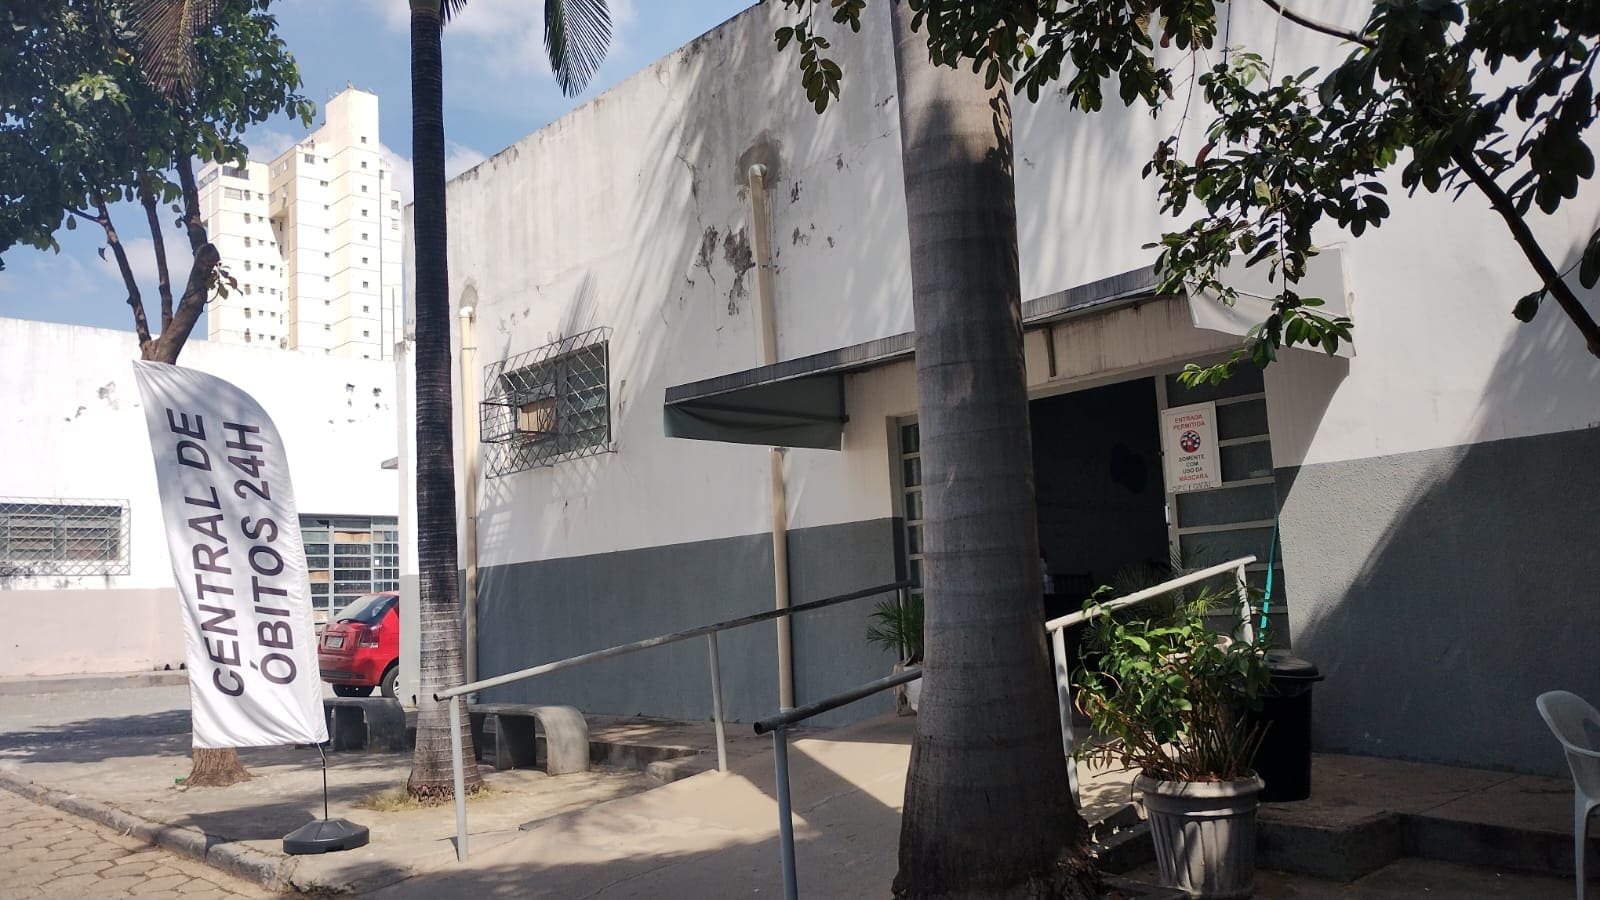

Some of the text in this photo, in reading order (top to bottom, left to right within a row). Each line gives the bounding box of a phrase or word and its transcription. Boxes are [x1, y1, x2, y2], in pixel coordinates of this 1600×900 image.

[1174, 414, 1203, 424] ENTRADA
[1173, 421, 1206, 430] PERMITIDA
[1178, 454, 1205, 462] SOMENTE
[166, 407, 246, 698] CENTRAL DE
[223, 422, 297, 685] ÓBITOS 24H
